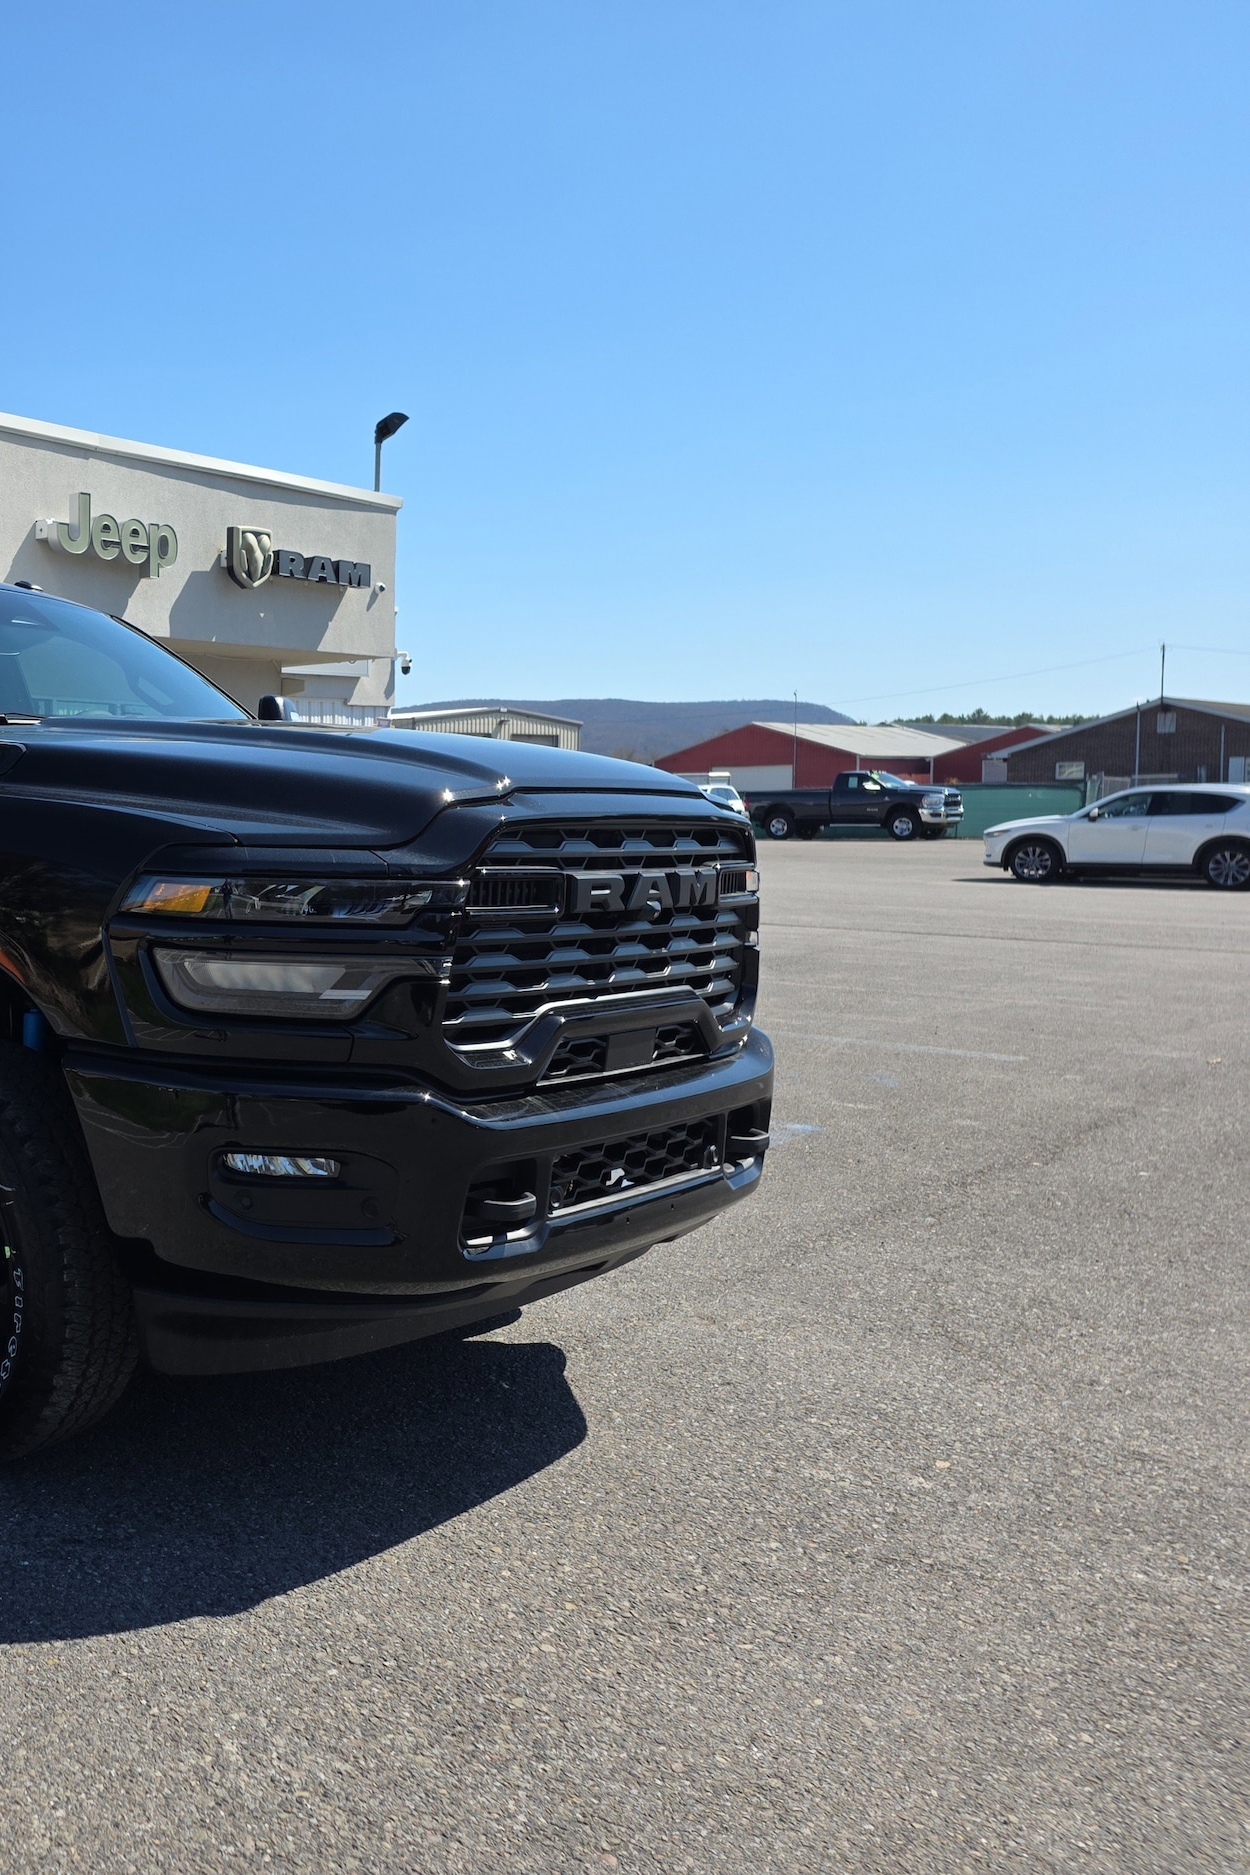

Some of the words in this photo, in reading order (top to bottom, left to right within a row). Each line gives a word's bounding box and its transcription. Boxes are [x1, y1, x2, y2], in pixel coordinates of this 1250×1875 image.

[52, 492, 178, 578] Jeep
[273, 549, 371, 588] RAM
[568, 868, 718, 914] RAM
